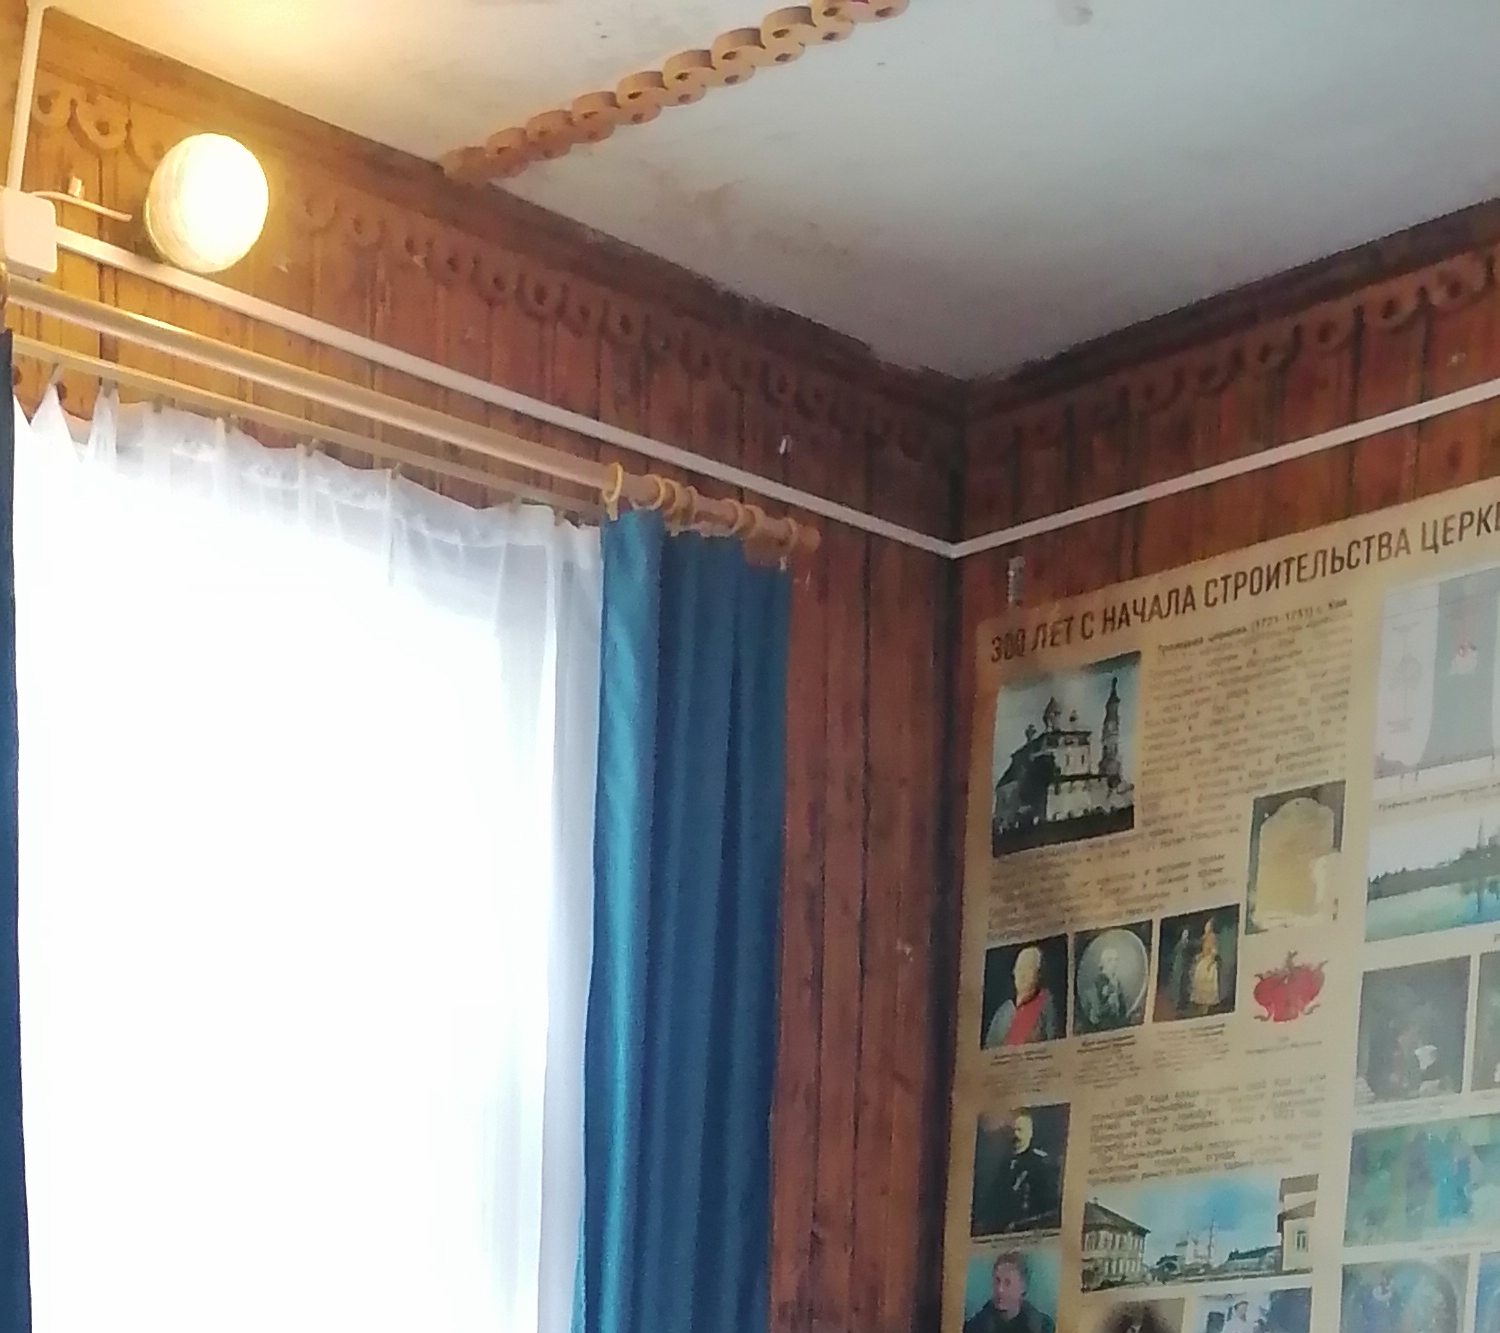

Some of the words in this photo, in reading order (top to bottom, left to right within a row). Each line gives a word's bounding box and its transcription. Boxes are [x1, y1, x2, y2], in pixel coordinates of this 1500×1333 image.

[991, 628, 1026, 662] 300
[1031, 616, 1074, 651] ЛЕТ
[1081, 612, 1095, 640] С
[1101, 584, 1197, 635] НАЧАЛА
[1203, 527, 1411, 608] СТРОИТЕЛЬСТВА
